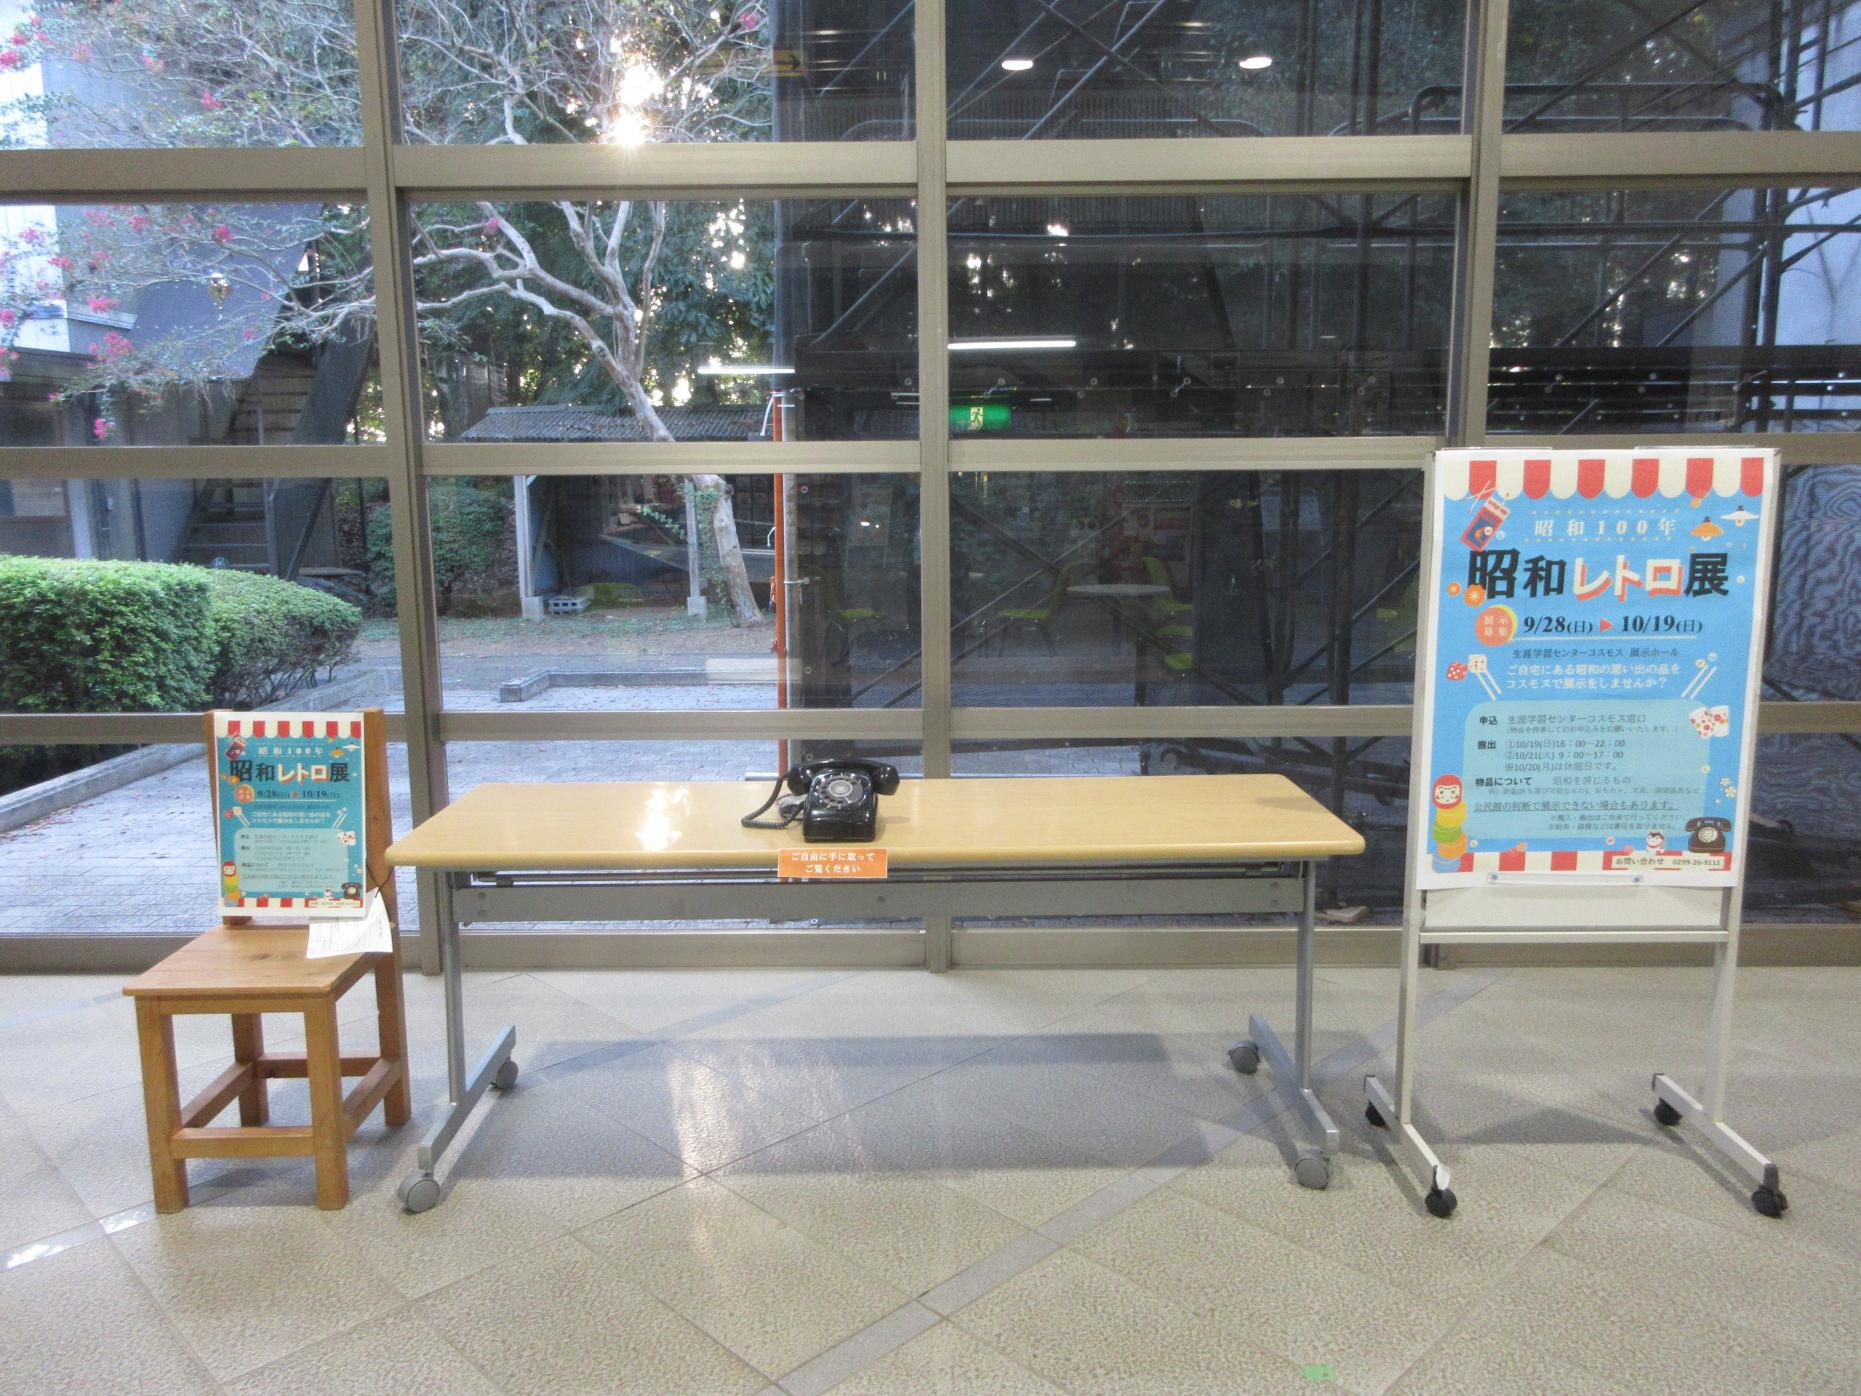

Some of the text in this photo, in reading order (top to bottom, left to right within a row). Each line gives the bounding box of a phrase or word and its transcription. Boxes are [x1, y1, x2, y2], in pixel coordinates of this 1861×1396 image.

[1534, 518, 1677, 536] 昭和100年
[1468, 548, 1730, 602] 昭和レトロ展
[1523, 615, 1703, 633] 9/28(日) 10/19(日)
[1512, 647, 1679, 659] 生涯学習センターコスモス 展示ホール
[1507, 663, 1681, 675] ご自宅にある昭和の思い出の品を
[1506, 678, 1667, 689] コスモスで展示をしませんか？
[1479, 716, 1498, 725] 申込
[230, 760, 350, 784] 昭和レトロ展
[1476, 776, 1532, 787] 物品について
[791, 852, 876, 861] ご自由に手に取って
[1616, 857, 1664, 865] お問い合わせ
[805, 864, 861, 874] ご覧ください
